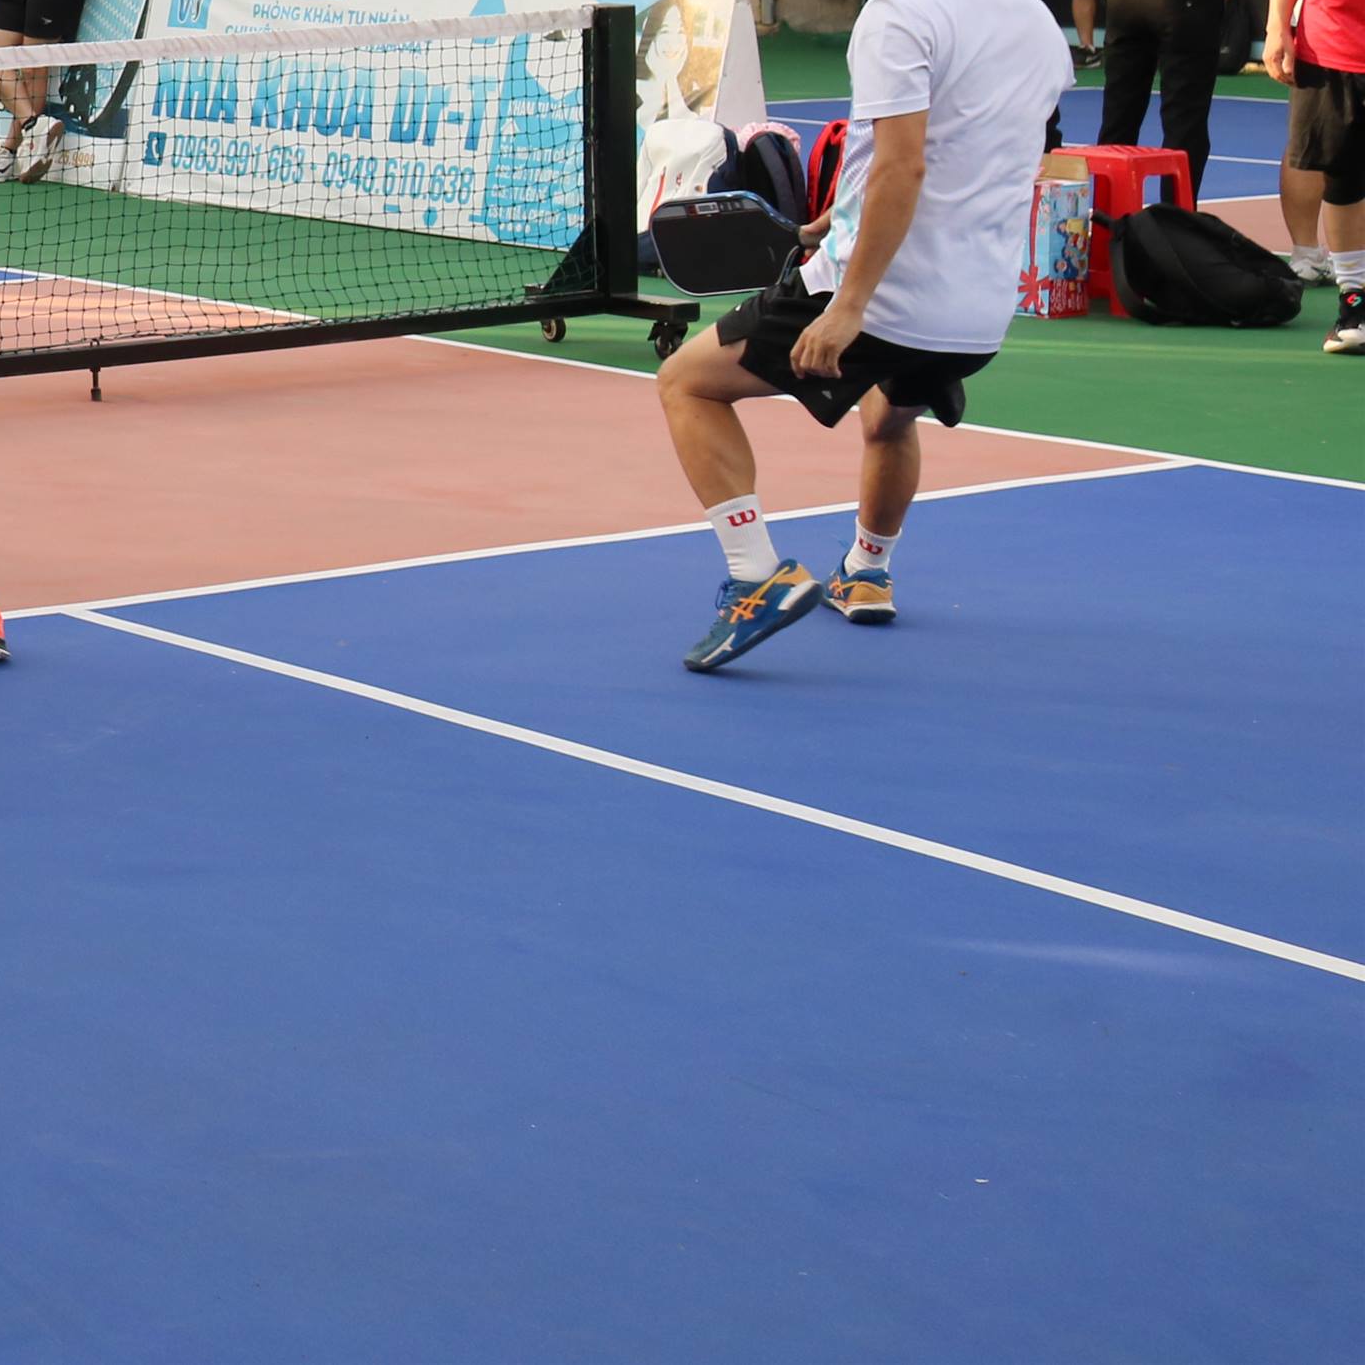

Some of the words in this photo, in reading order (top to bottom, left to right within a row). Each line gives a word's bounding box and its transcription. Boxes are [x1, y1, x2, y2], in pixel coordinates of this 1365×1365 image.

[250, 59, 377, 140] KHOA
[171, 134, 305, 184] 0963.991.663
[323, 151, 476, 205] 0948.610.638
